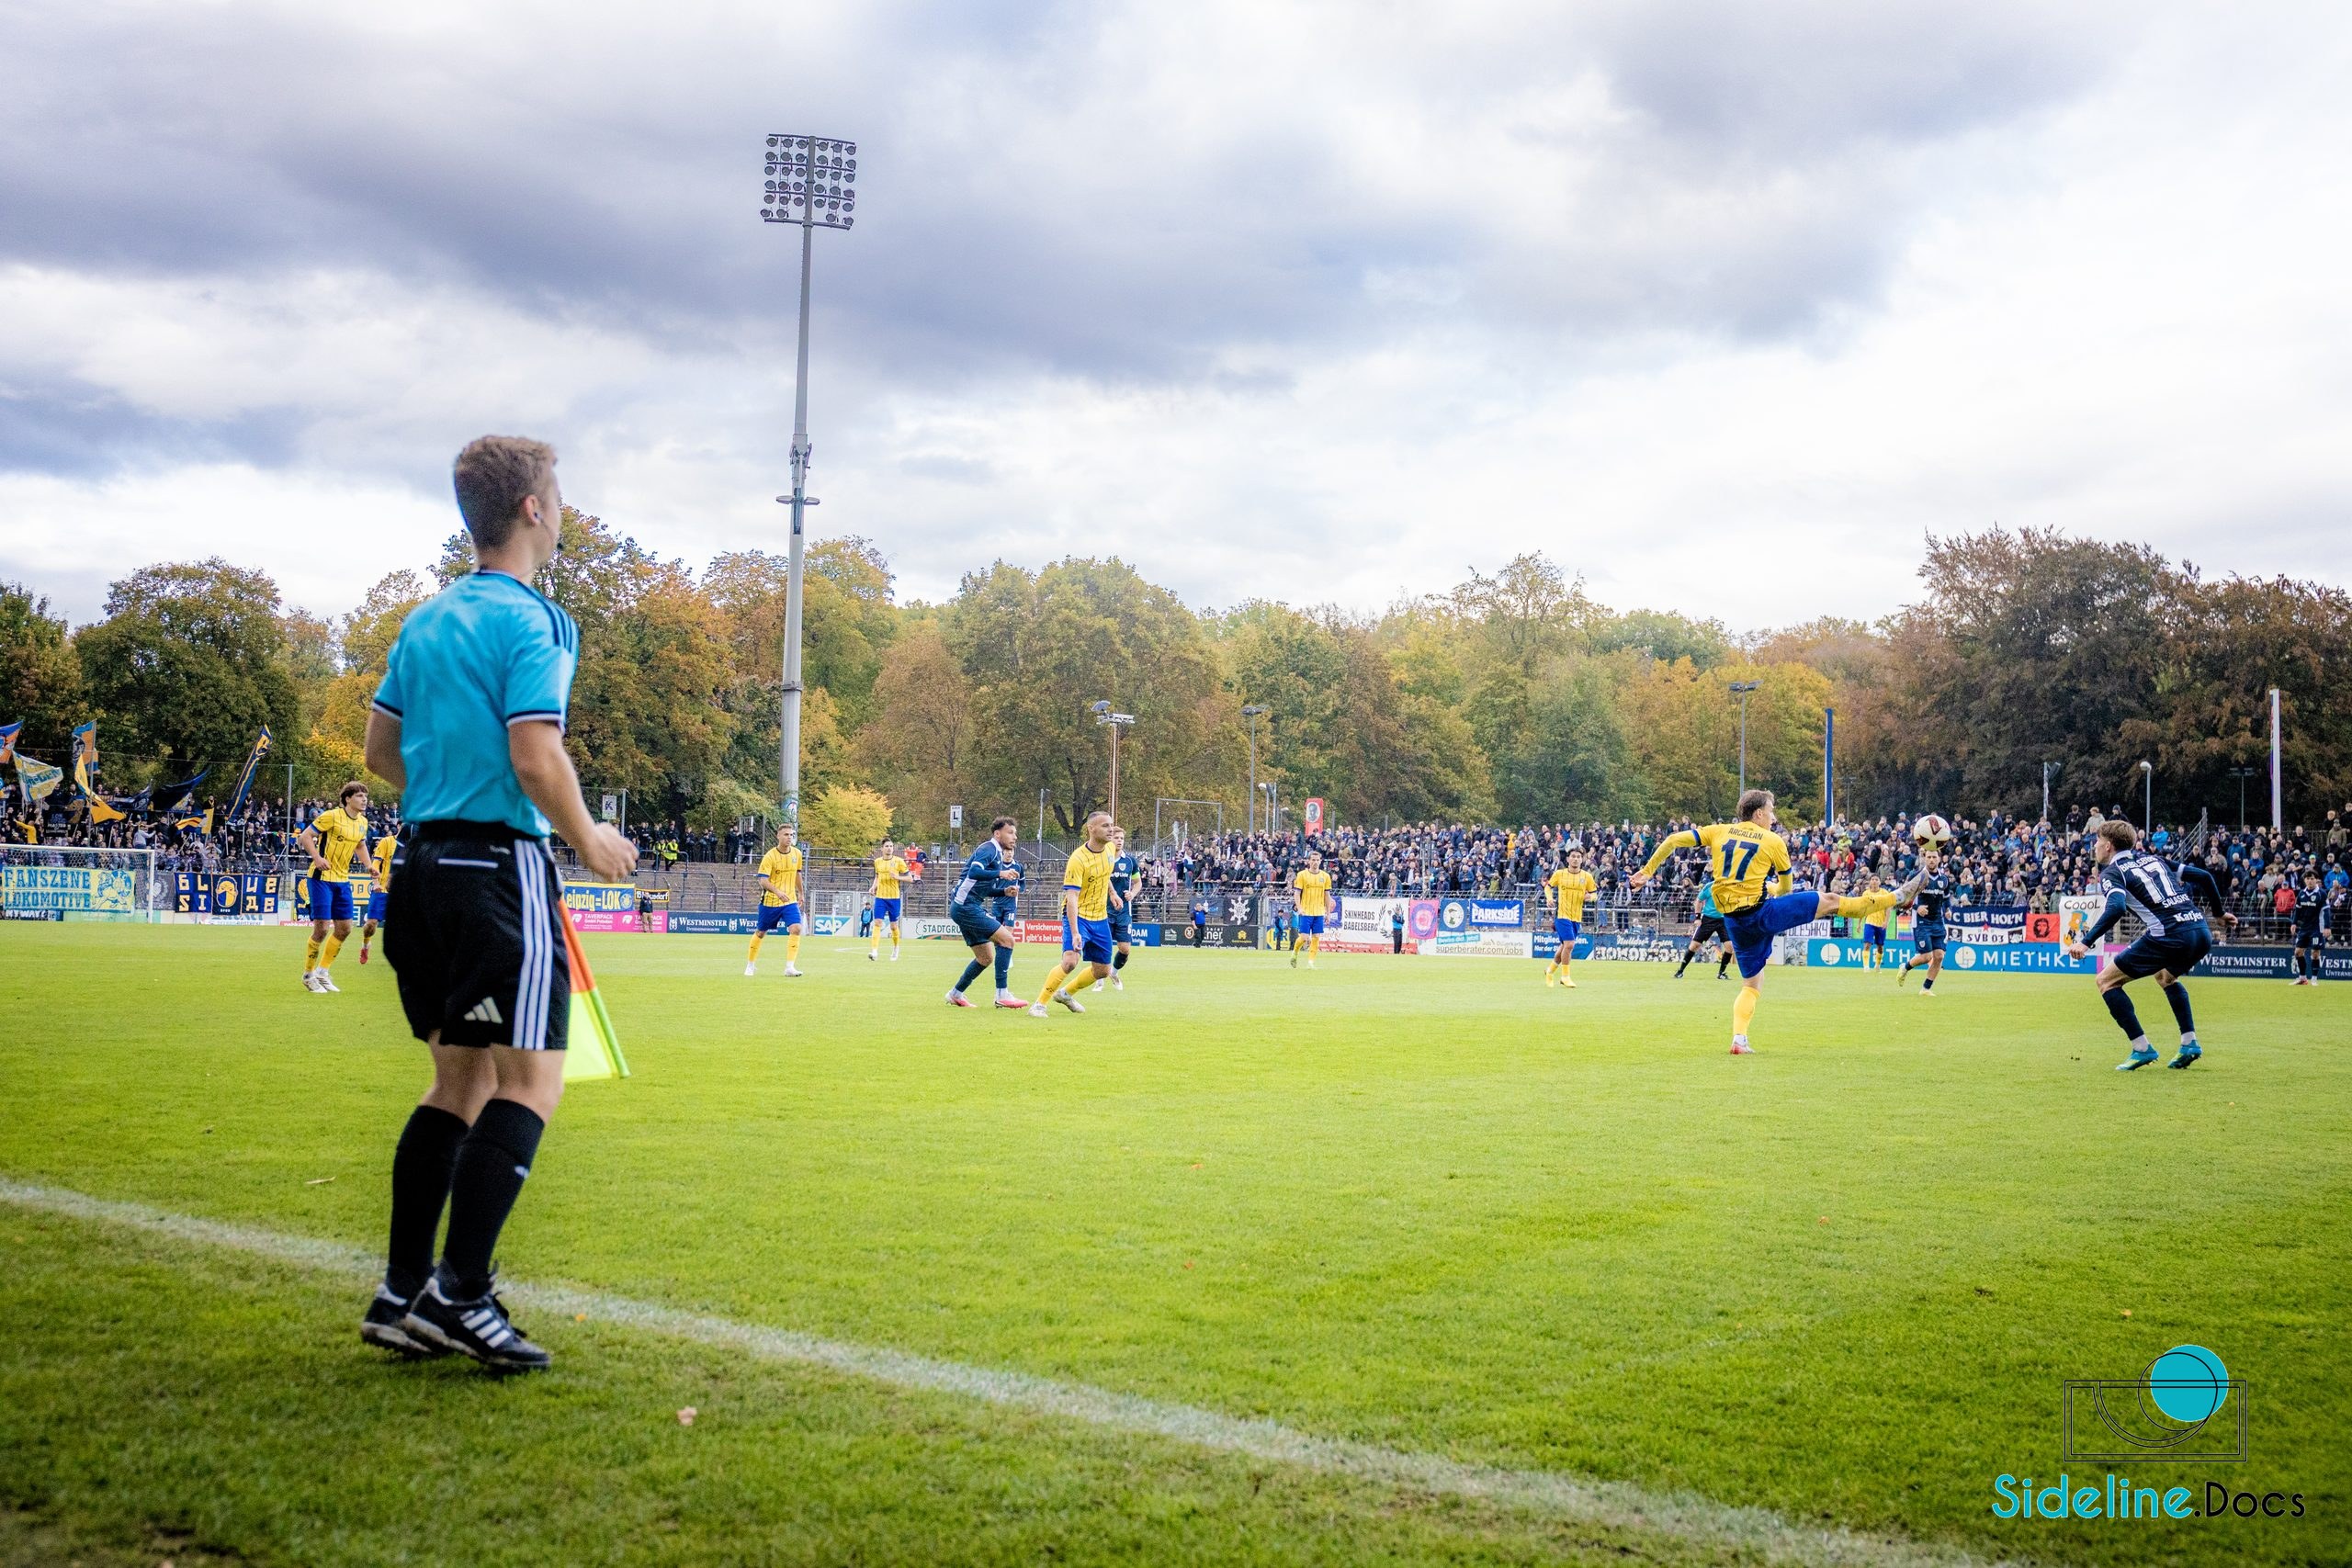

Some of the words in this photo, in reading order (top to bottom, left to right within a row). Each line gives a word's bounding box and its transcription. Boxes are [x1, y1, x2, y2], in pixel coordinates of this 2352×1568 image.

[1721, 839, 1759, 882] 17
[5, 869, 91, 888] FANSZENE
[2130, 861, 2177, 904] 17
[5, 890, 91, 908] LOKOMOTIVE
[566, 888, 621, 911] eipzig=LOK
[2064, 898, 2100, 910] COOOL
[1344, 909, 1375, 919] SKINHEADS
[1472, 907, 1520, 920] PARKSIDE
[1963, 911, 1988, 923] BIER
[679, 917, 727, 927] WESTMINSTER
[739, 918, 785, 928] WESTER
[815, 919, 842, 932] SAP
[1026, 923, 1063, 932] Versicherung
[1343, 921, 1378, 931] BABELSBERG
[922, 924, 961, 933] STADTGRU
[1967, 933, 1988, 942] SVB
[1991, 933, 2004, 942] 03
[1436, 944, 1524, 955] superberater.com/jobs
[1983, 951, 2081, 967] MIETHKE
[2199, 953, 2287, 967] WESTMINSTER
